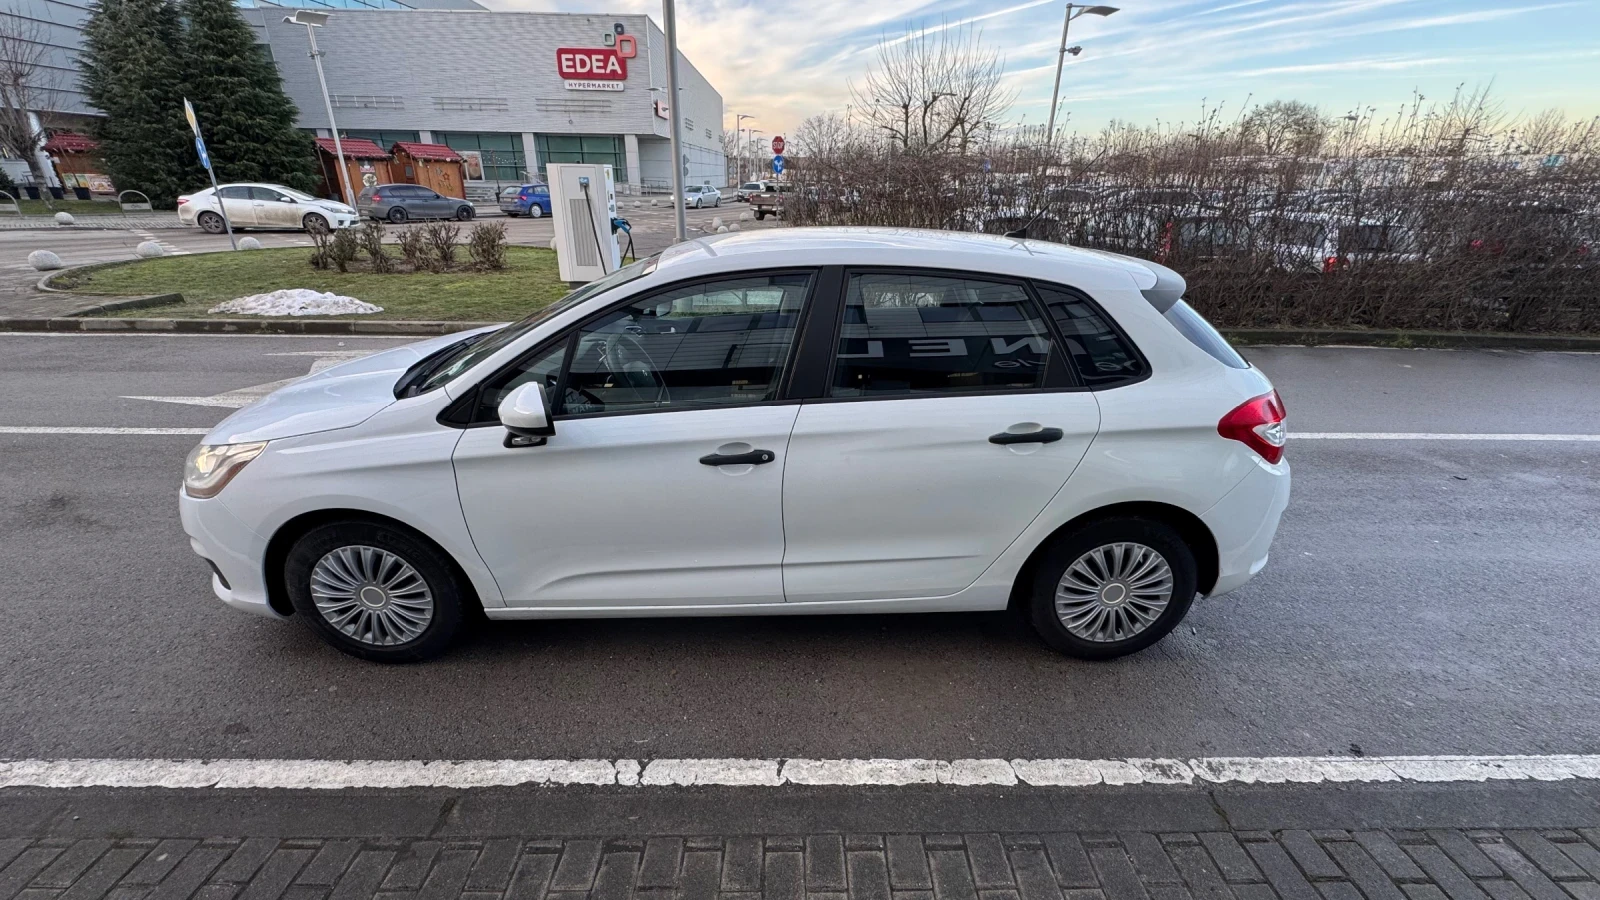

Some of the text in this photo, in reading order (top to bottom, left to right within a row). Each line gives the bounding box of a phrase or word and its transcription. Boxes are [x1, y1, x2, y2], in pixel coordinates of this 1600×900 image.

[561, 53, 622, 74] EDEA
[568, 82, 620, 90] HYPERMARKET
[772, 141, 785, 149] STOP
